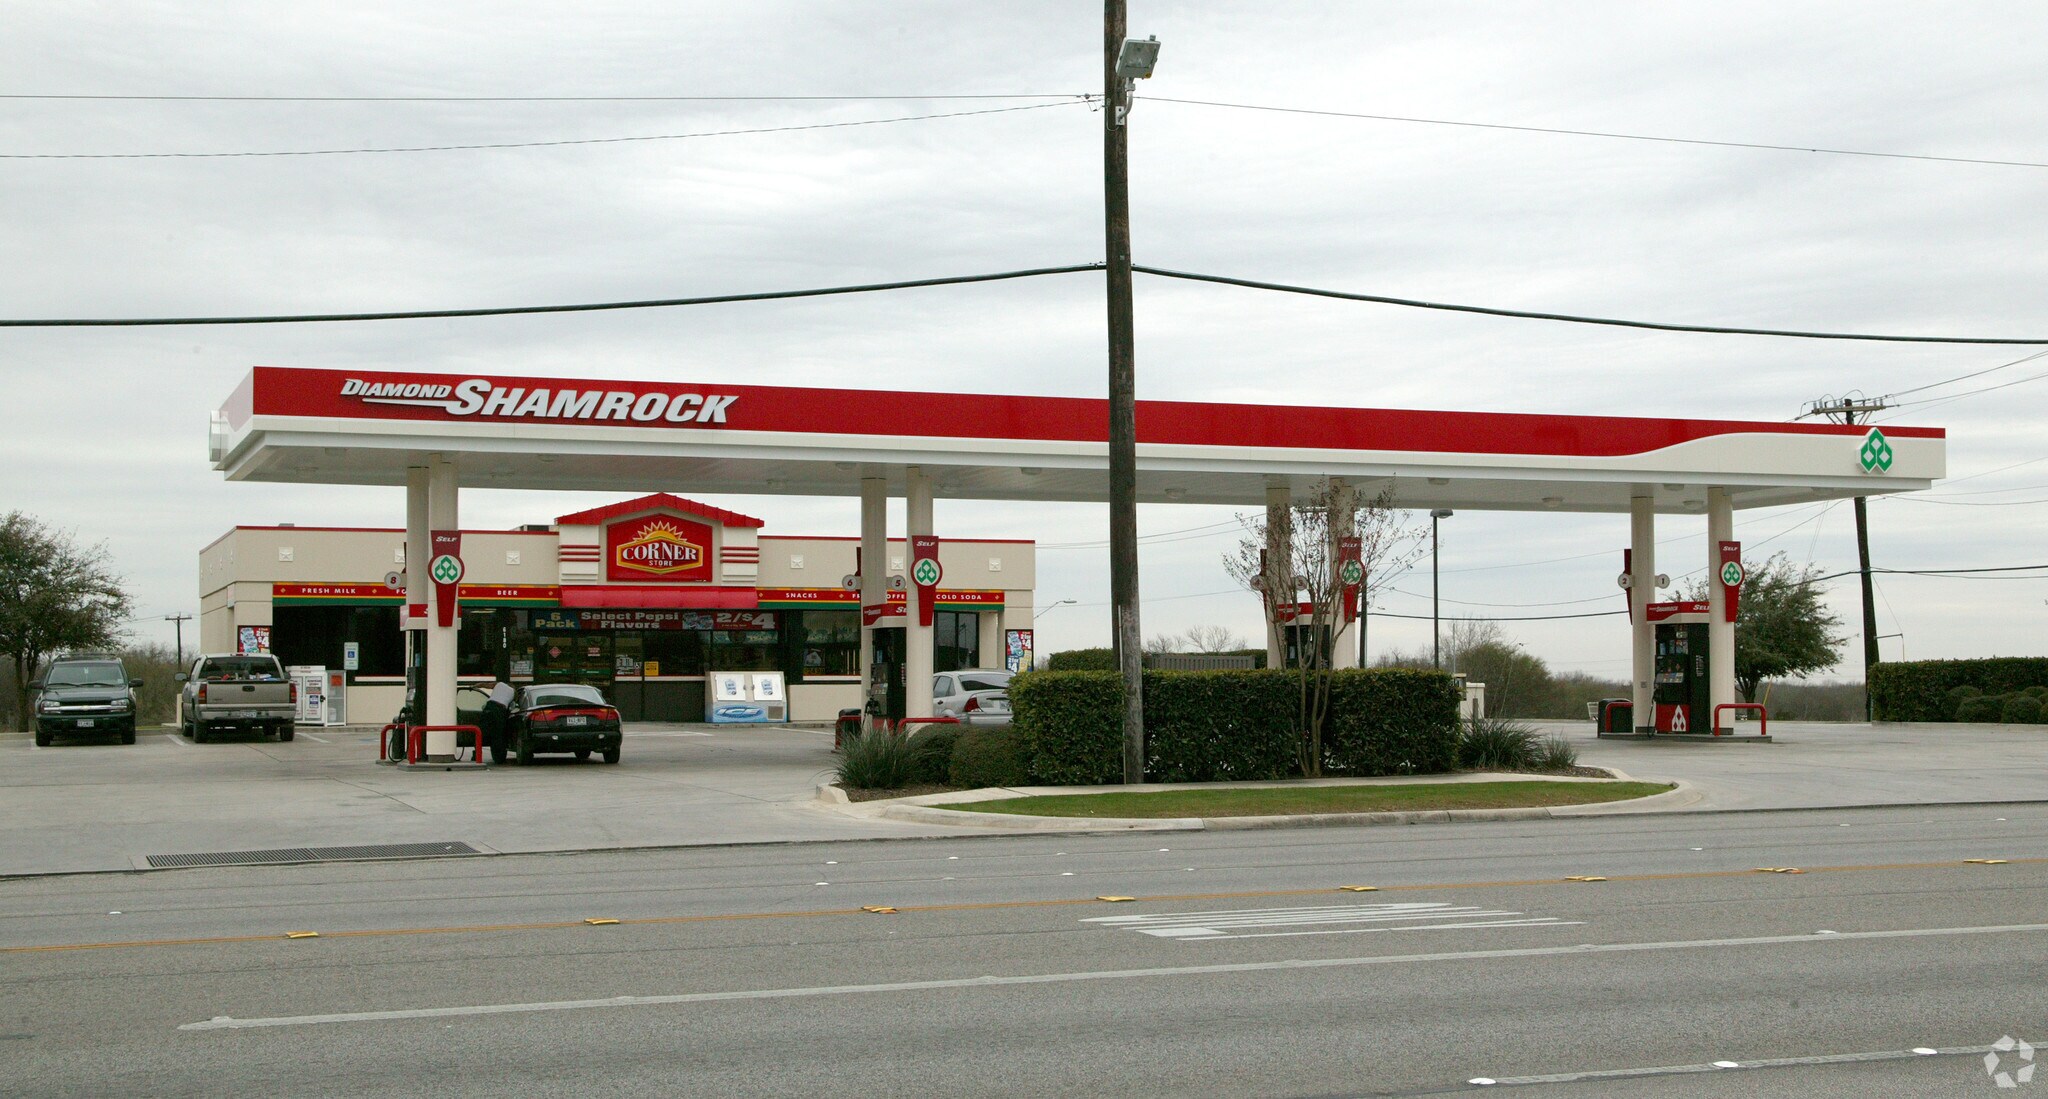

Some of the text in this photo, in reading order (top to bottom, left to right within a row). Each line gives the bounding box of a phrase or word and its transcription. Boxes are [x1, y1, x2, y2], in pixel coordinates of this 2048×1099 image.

[340, 378, 740, 424] DIAMOND SHAMROCK
[622, 542, 697, 560] CORNER
[551, 612, 561, 620] 6
[581, 612, 679, 622] Select Pepsi
[716, 612, 776, 629] 2/$4
[535, 619, 575, 628] Pack
[600, 620, 660, 629] Flavors
